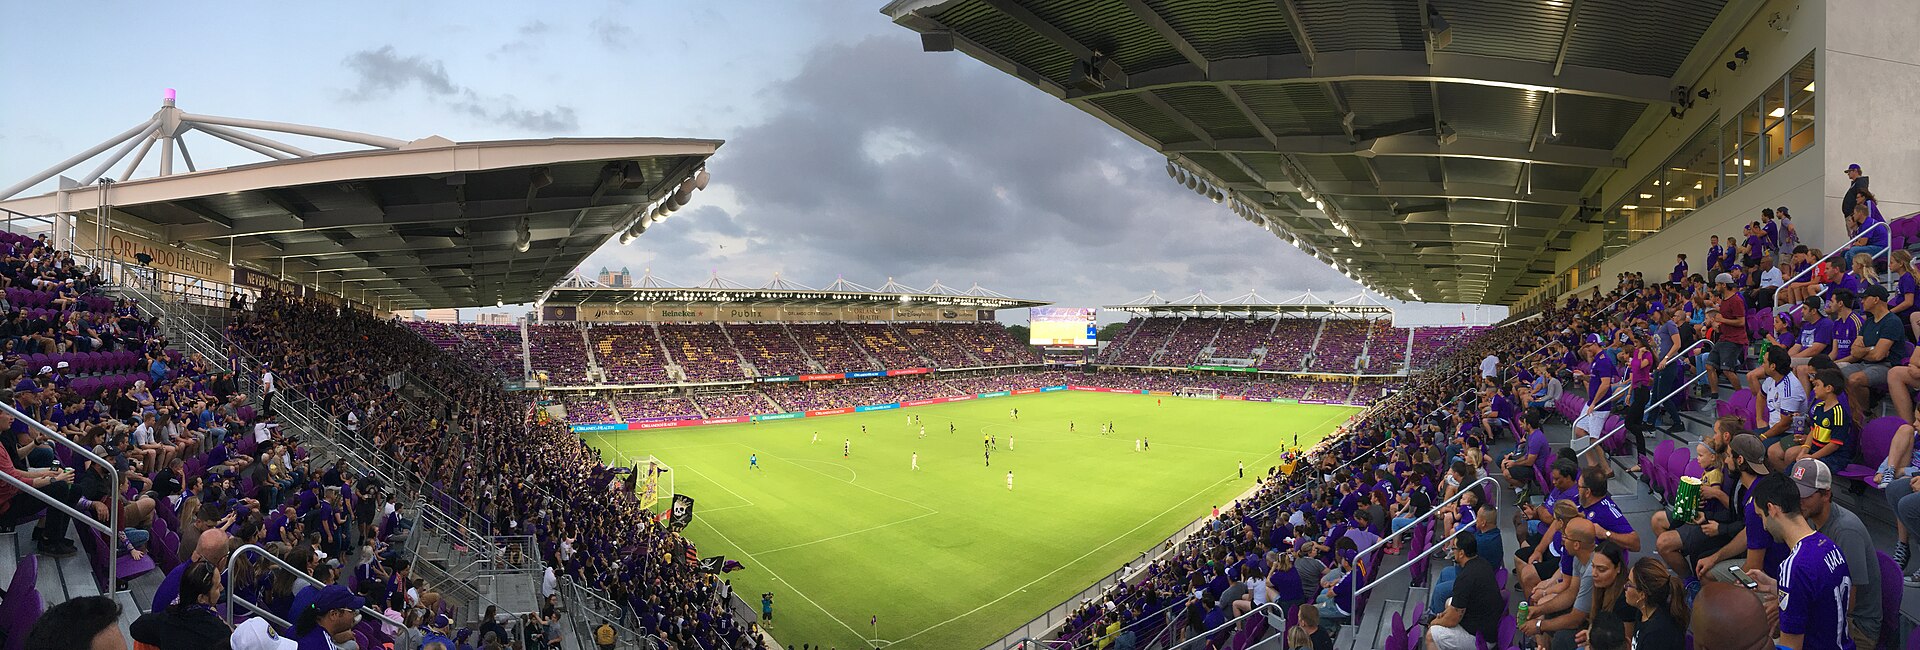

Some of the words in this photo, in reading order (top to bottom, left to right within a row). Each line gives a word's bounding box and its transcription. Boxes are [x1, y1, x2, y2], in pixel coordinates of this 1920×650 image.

[176, 252, 213, 277] HEALTH
[246, 271, 266, 287] NEVER
[731, 309, 762, 318] Publix
[1386, 486, 1394, 500] 5
[1823, 544, 1846, 574] KAKÁ
